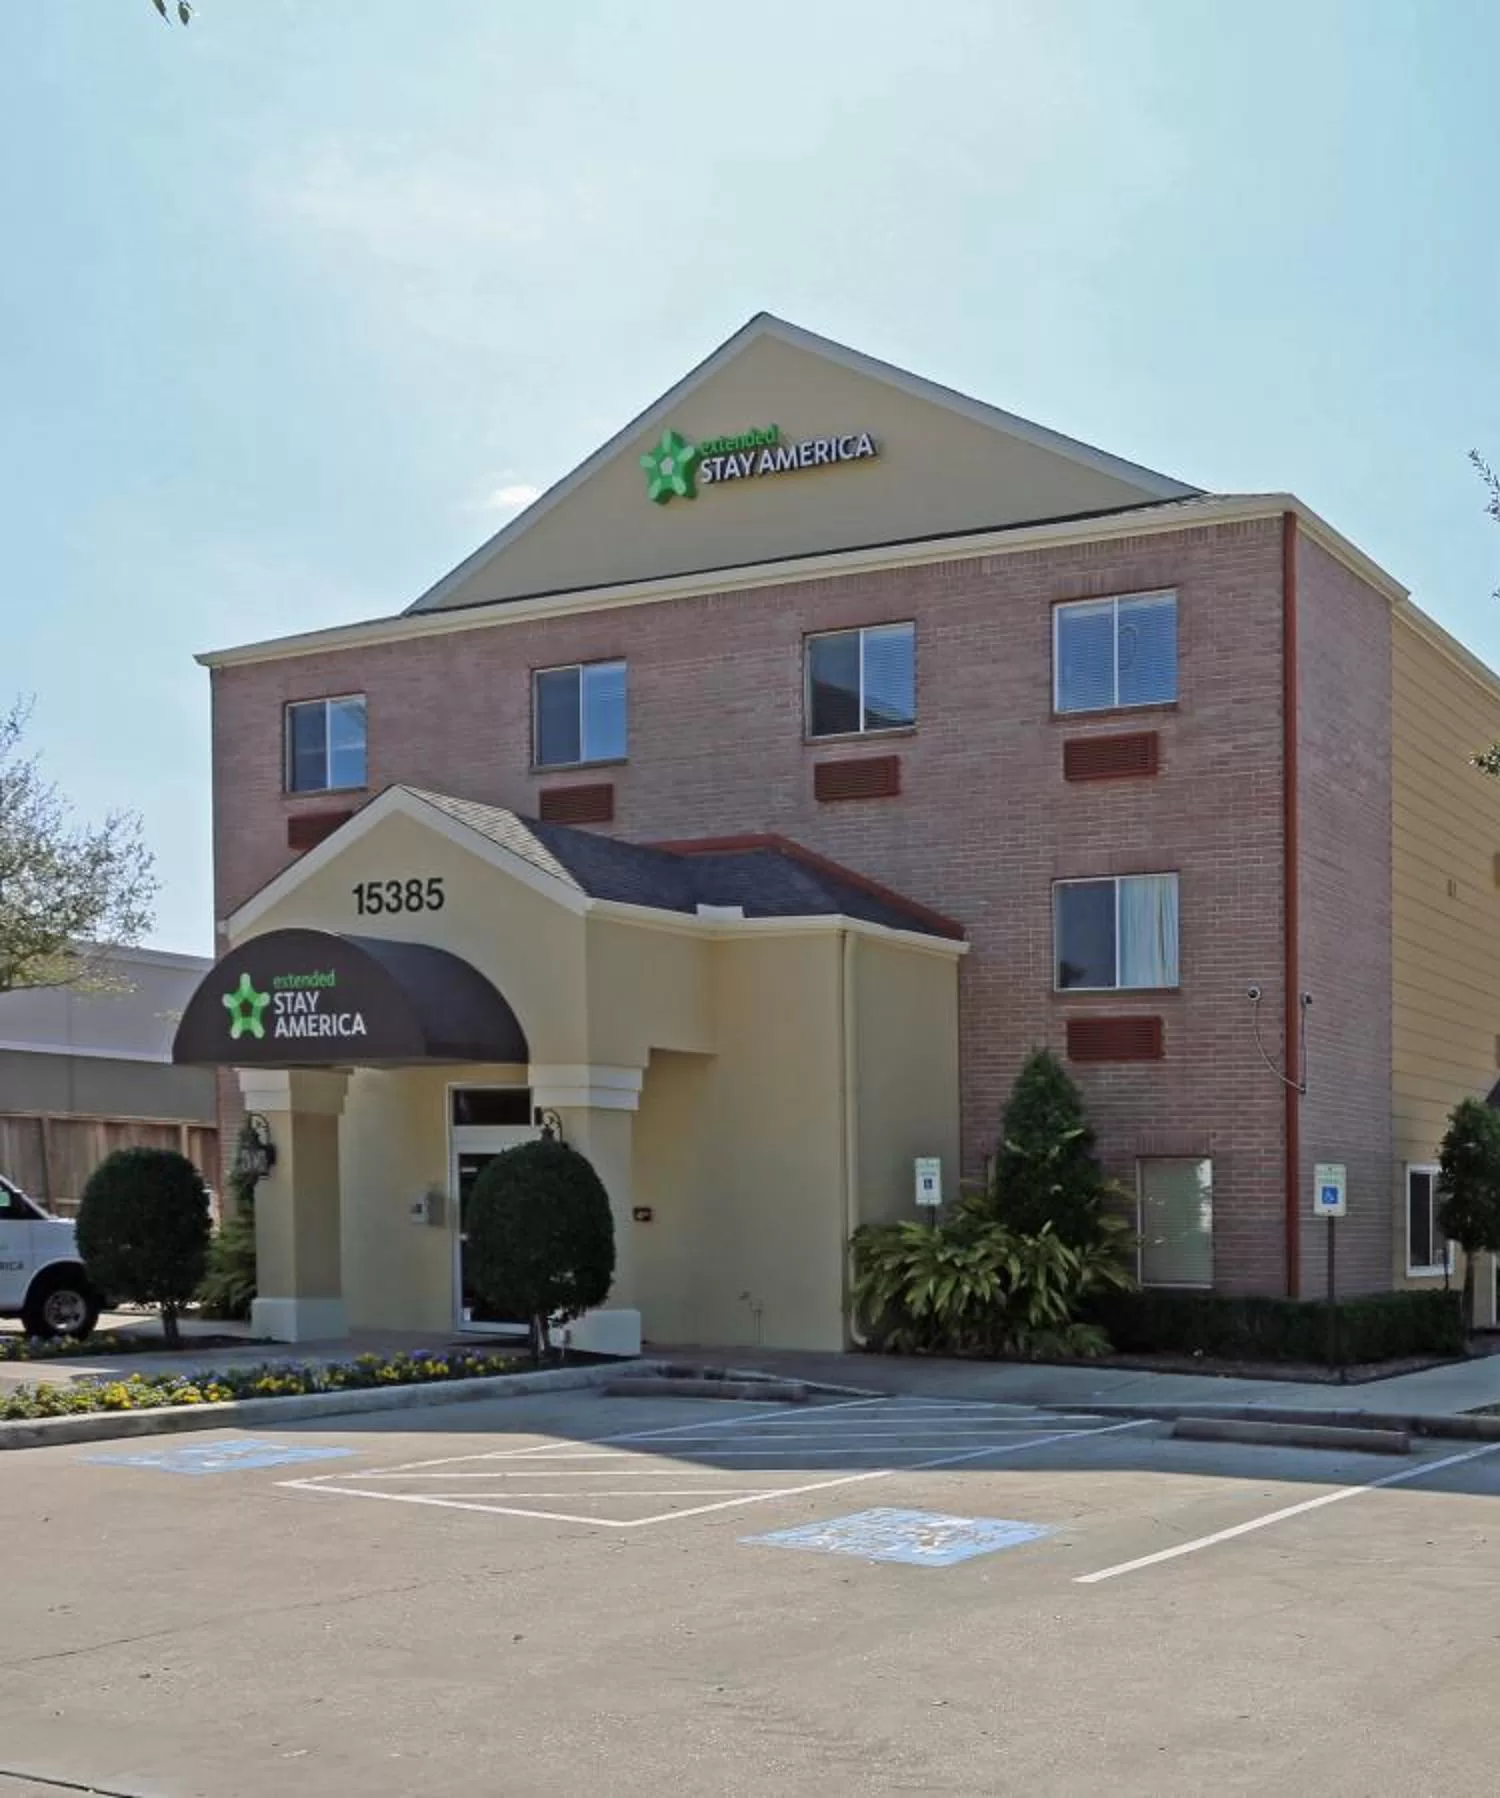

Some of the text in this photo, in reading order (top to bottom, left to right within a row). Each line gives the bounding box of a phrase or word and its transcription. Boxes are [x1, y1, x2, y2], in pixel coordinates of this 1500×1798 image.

[701, 424, 778, 453] extended
[701, 433, 876, 483] STAY AMERICA
[352, 878, 444, 914] 15385
[273, 968, 336, 989] extended
[274, 991, 320, 1014] STAY
[275, 1011, 367, 1038] AMERICA
